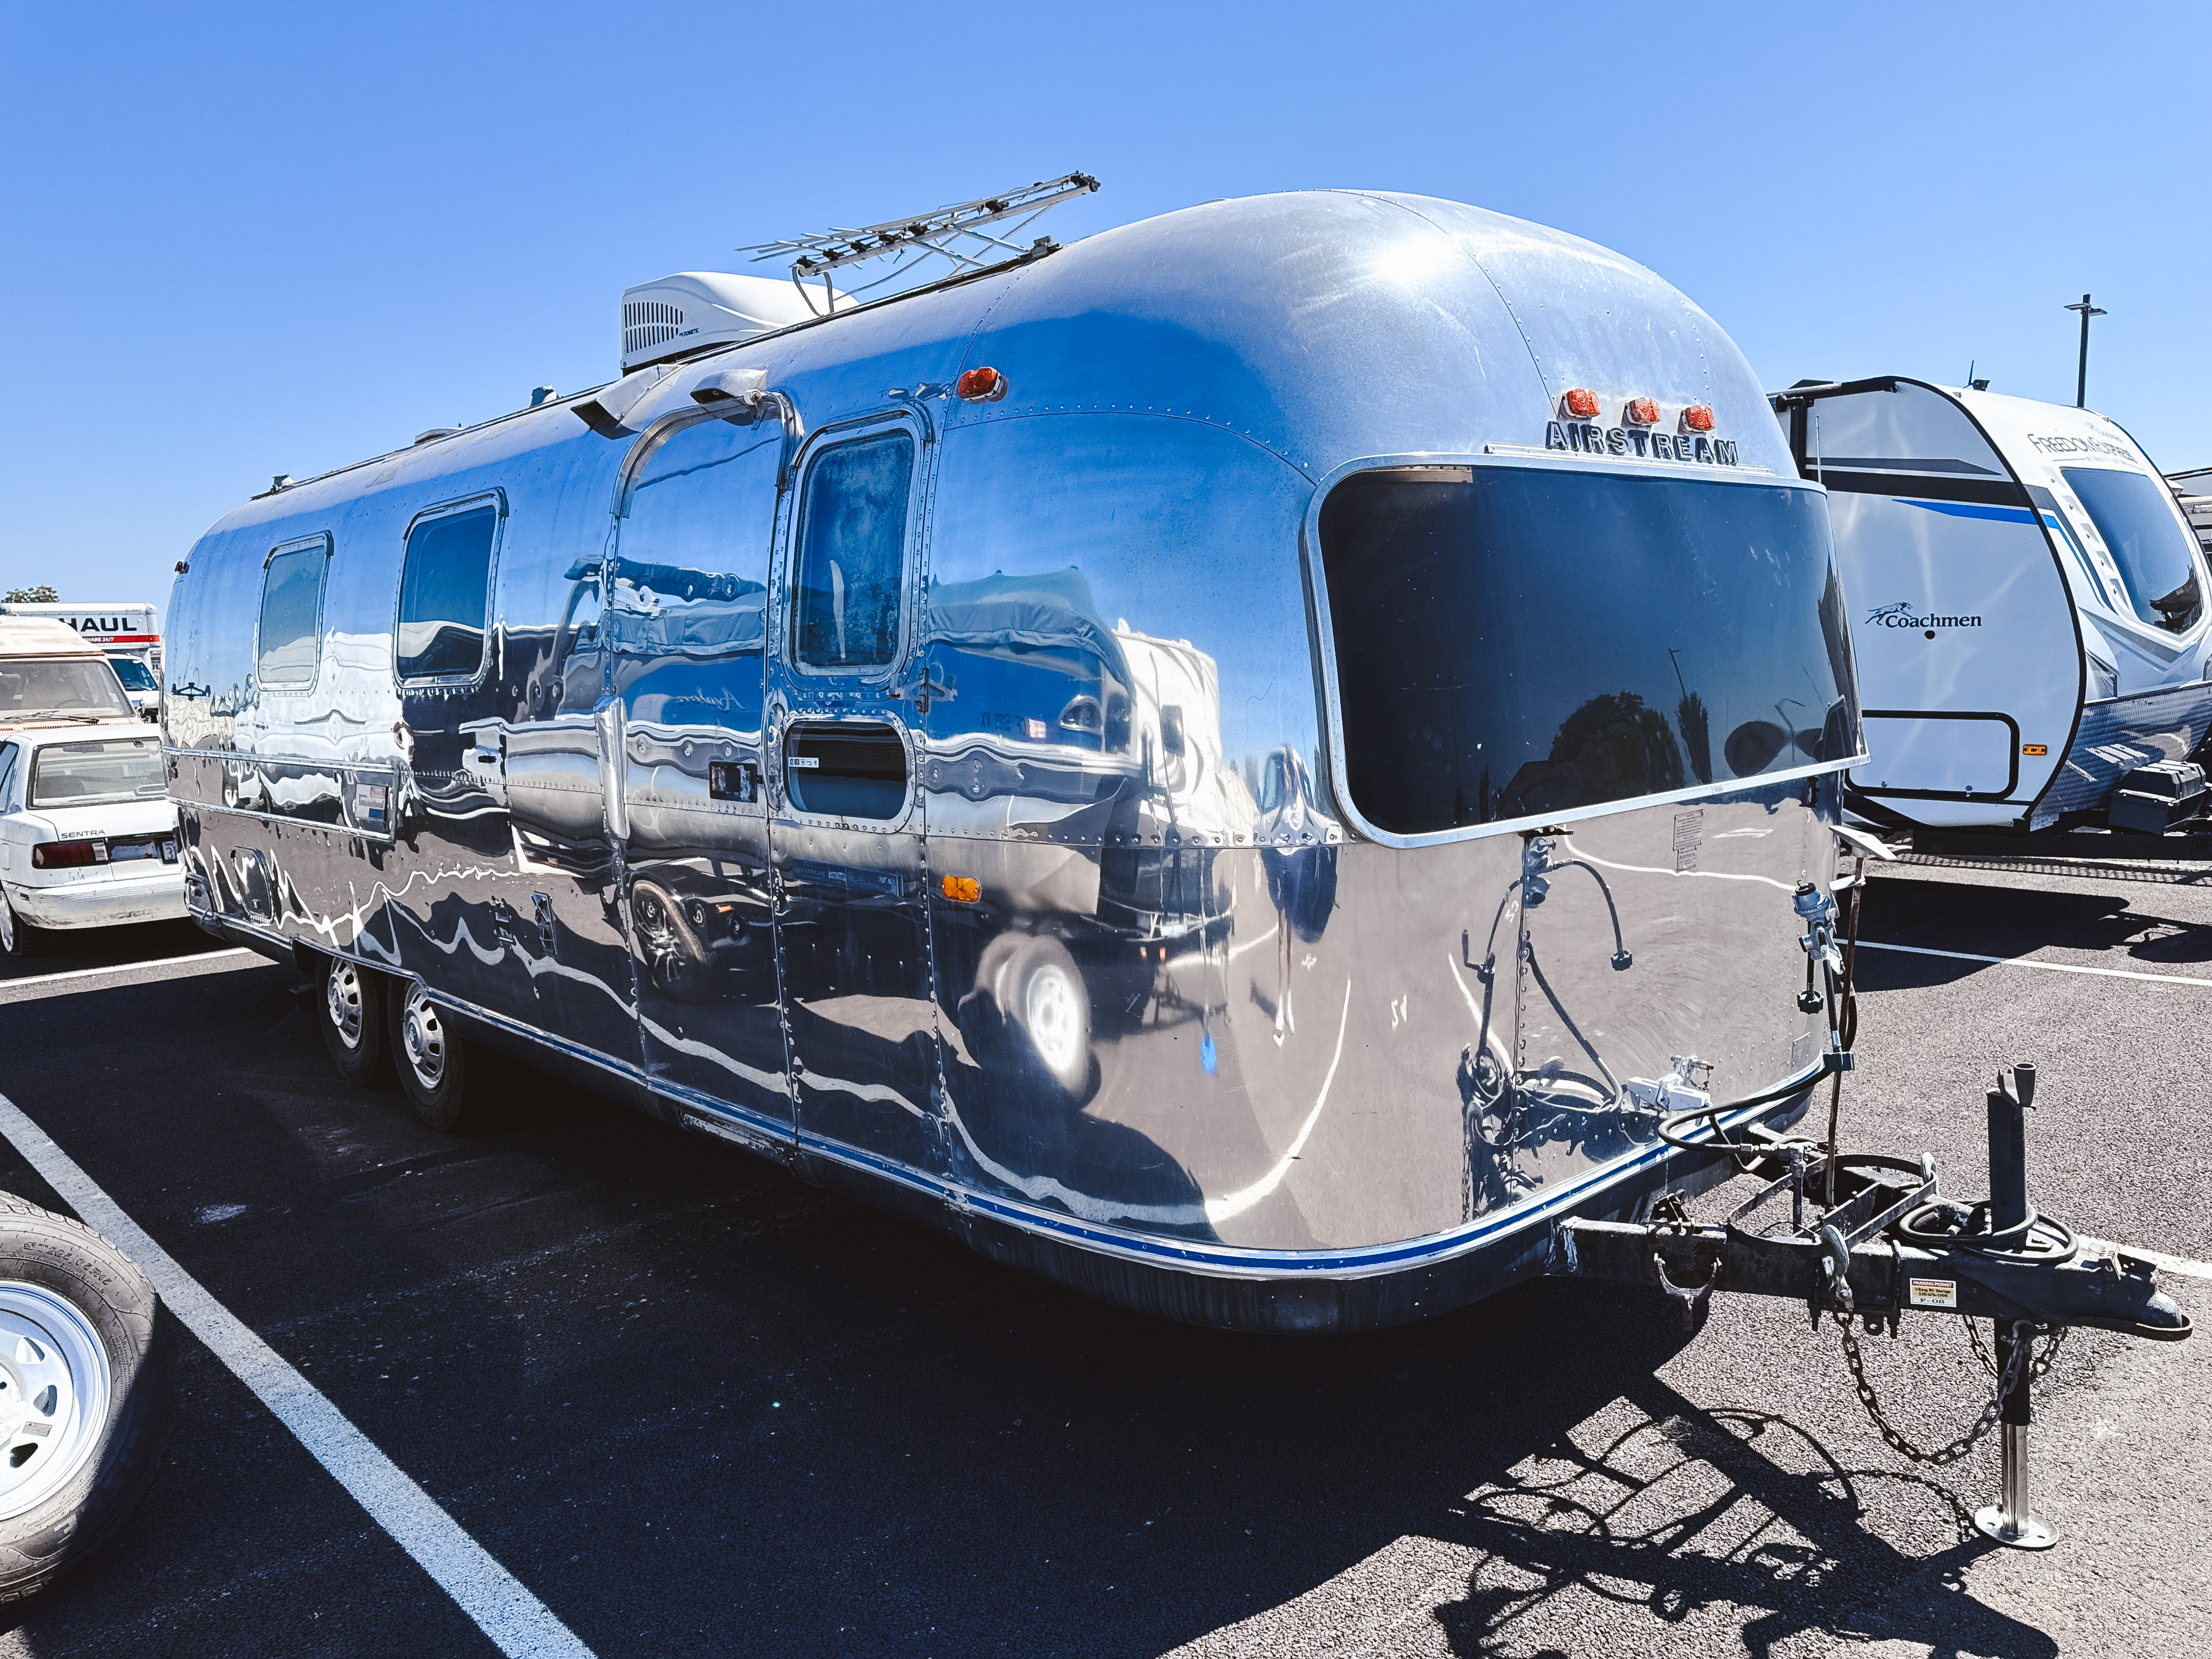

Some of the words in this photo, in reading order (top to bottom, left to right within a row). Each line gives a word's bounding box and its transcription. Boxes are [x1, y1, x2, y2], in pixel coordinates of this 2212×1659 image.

[1545, 421, 1739, 466] AIRSTREAM
[1885, 613, 1982, 628] Coachmen
[61, 830, 105, 839] SENTRA
